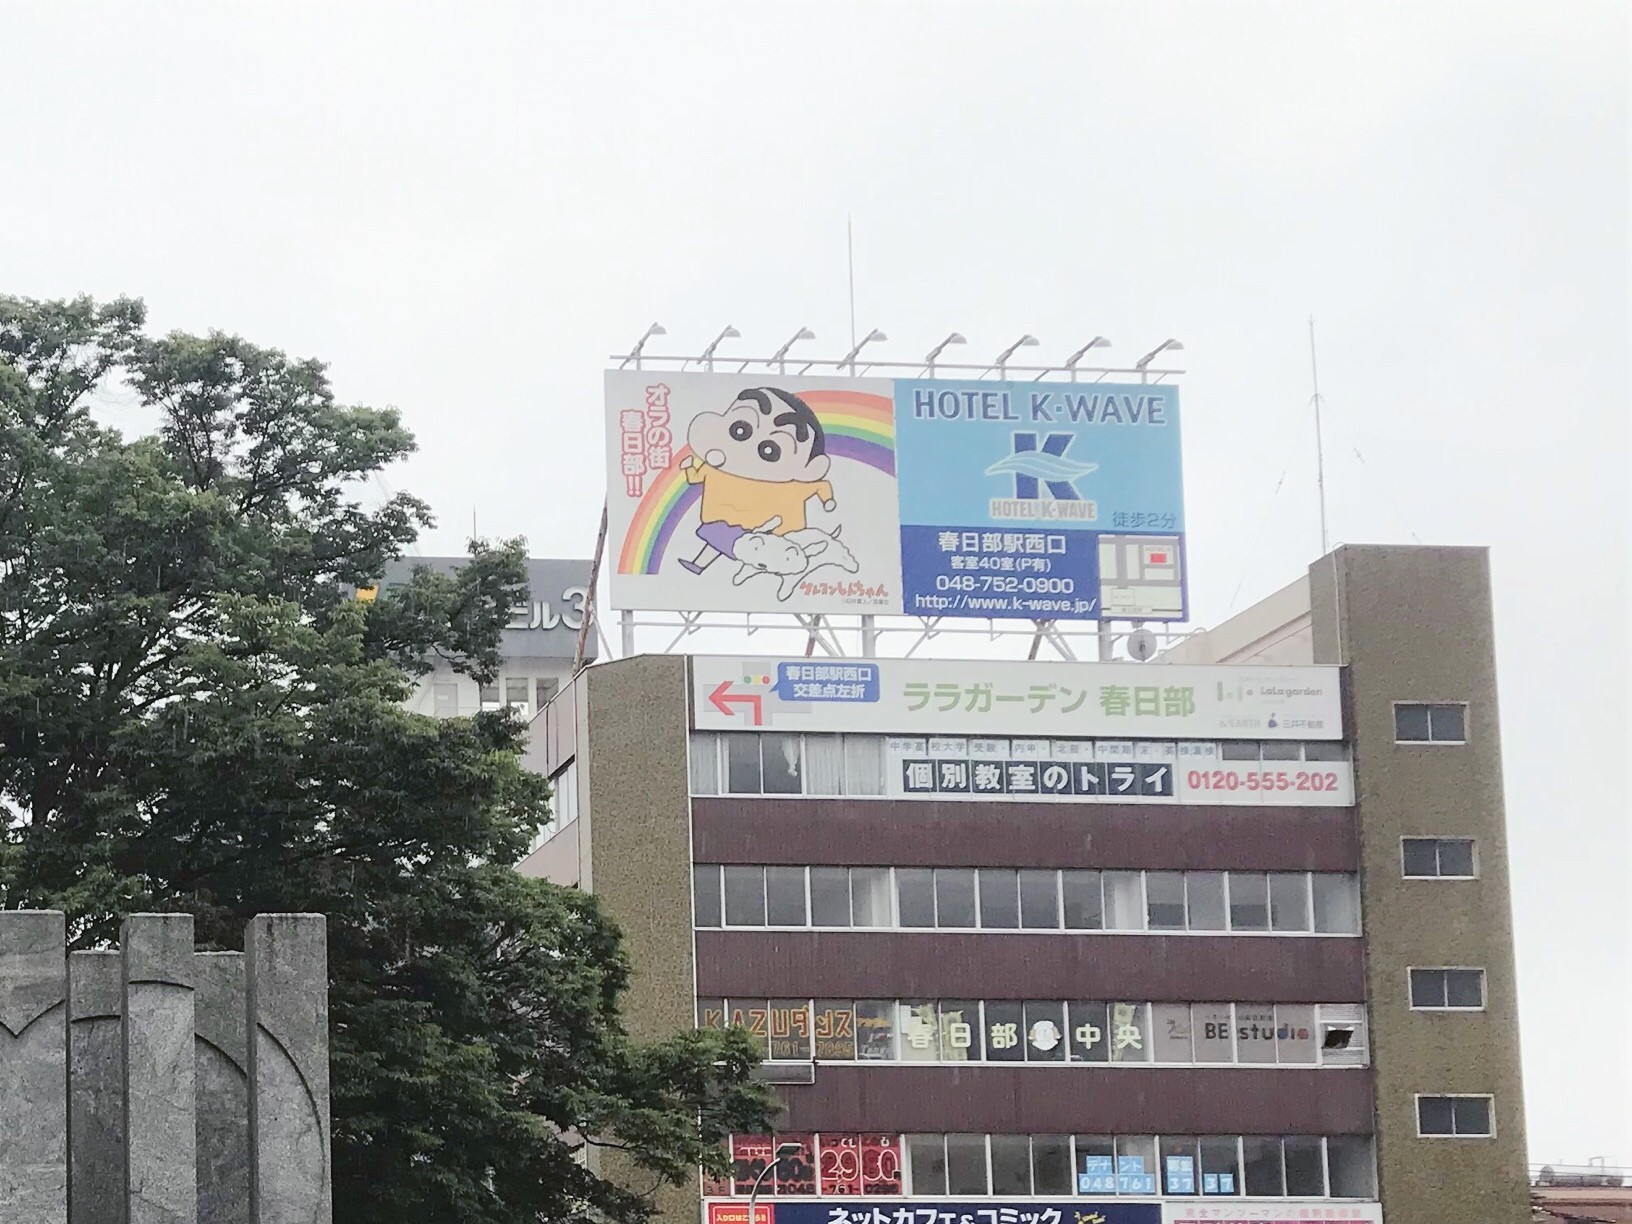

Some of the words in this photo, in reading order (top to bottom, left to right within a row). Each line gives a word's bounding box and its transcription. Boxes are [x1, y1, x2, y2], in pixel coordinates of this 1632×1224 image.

[913, 389, 1019, 421] HOTEL
[647, 384, 672, 469] オラの街
[991, 500, 1035, 517] HOTEL
[1112, 511, 1176, 528] 徒歩2分
[938, 532, 1066, 554] 春日部駅西口
[936, 576, 1074, 593] 048-752-0900
[915, 594, 1097, 612] http://www.k-wave.jp/
[786, 666, 872, 682] 春日部駅西口
[793, 683, 866, 699] 交差点左折
[903, 682, 1087, 713] ララガーデン
[1100, 685, 1196, 717] 春日部
[906, 763, 1169, 793] 個別教室のトライ
[1187, 770, 1339, 792] 0120-555-202
[1076, 1023, 1142, 1050] 中央
[1205, 1022, 1229, 1040] BE
[1238, 1022, 1309, 1041] studio
[1088, 1159, 1142, 1171] テナント
